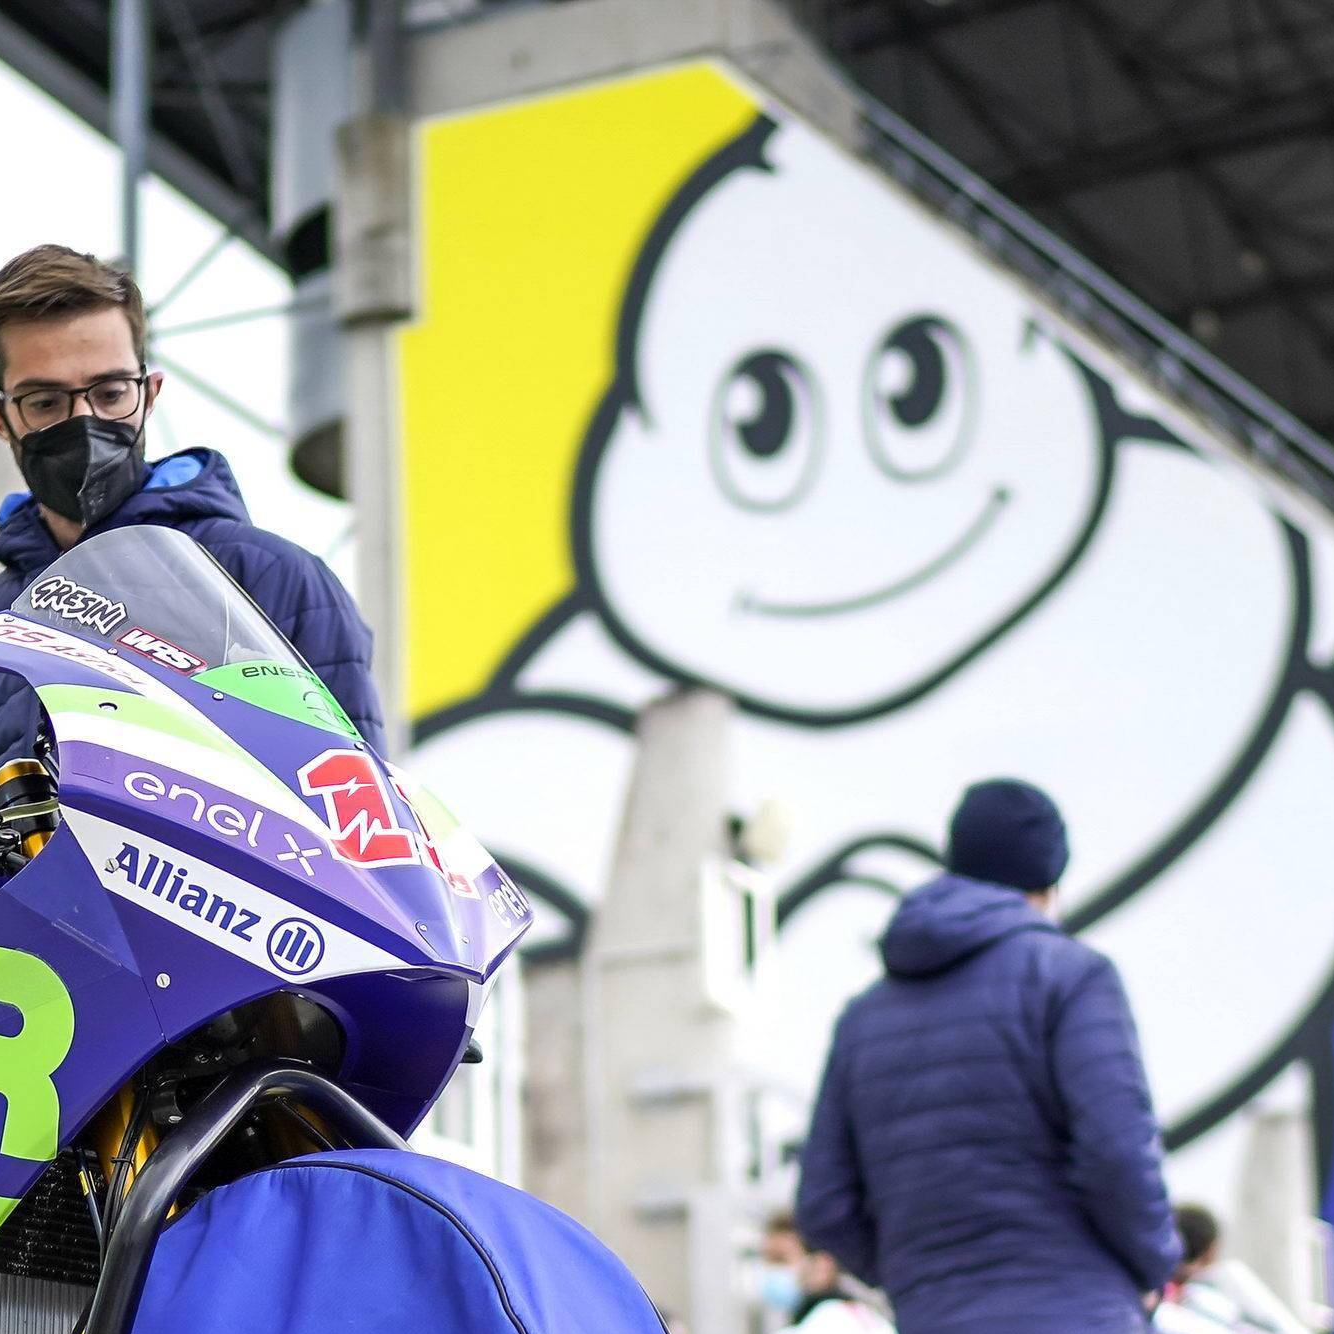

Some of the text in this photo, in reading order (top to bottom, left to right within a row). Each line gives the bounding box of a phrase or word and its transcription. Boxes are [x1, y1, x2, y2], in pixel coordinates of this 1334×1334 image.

[32, 577, 127, 634] GRESINI
[120, 630, 202, 668] WRS
[124, 771, 264, 848] enel
[105, 842, 262, 942] Allianz
